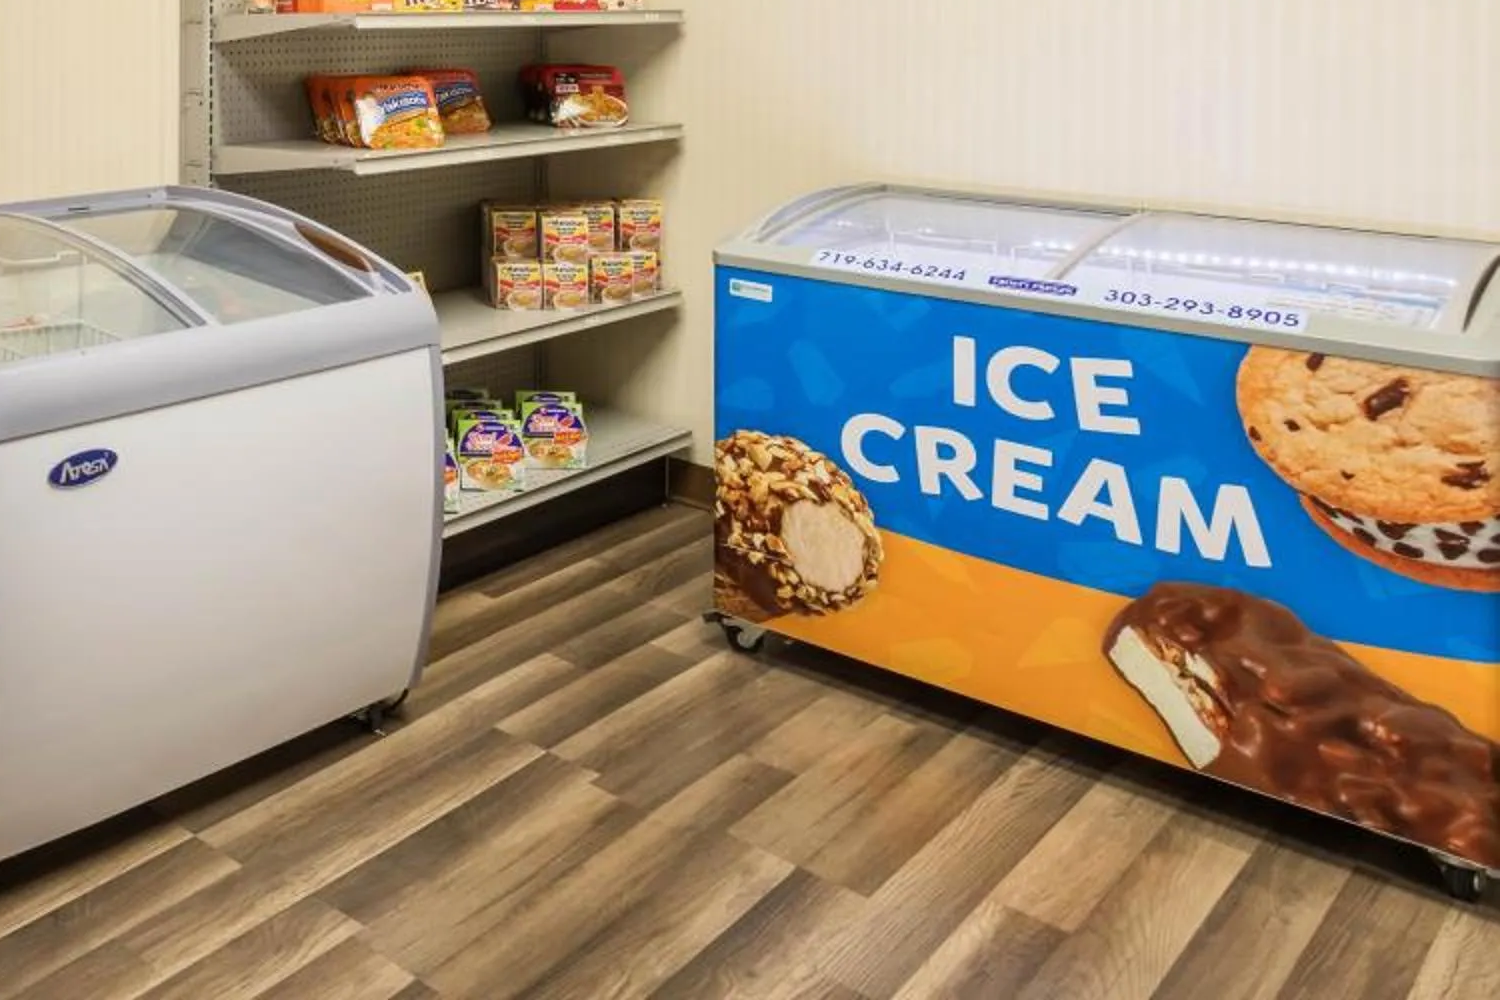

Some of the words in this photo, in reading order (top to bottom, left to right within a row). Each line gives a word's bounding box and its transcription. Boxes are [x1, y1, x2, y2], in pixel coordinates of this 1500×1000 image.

[818, 251, 967, 282] 719-634-6244
[1104, 288, 1300, 328] 303-293-8905
[951, 335, 1142, 436] ICE
[840, 411, 1273, 568] CREAM
